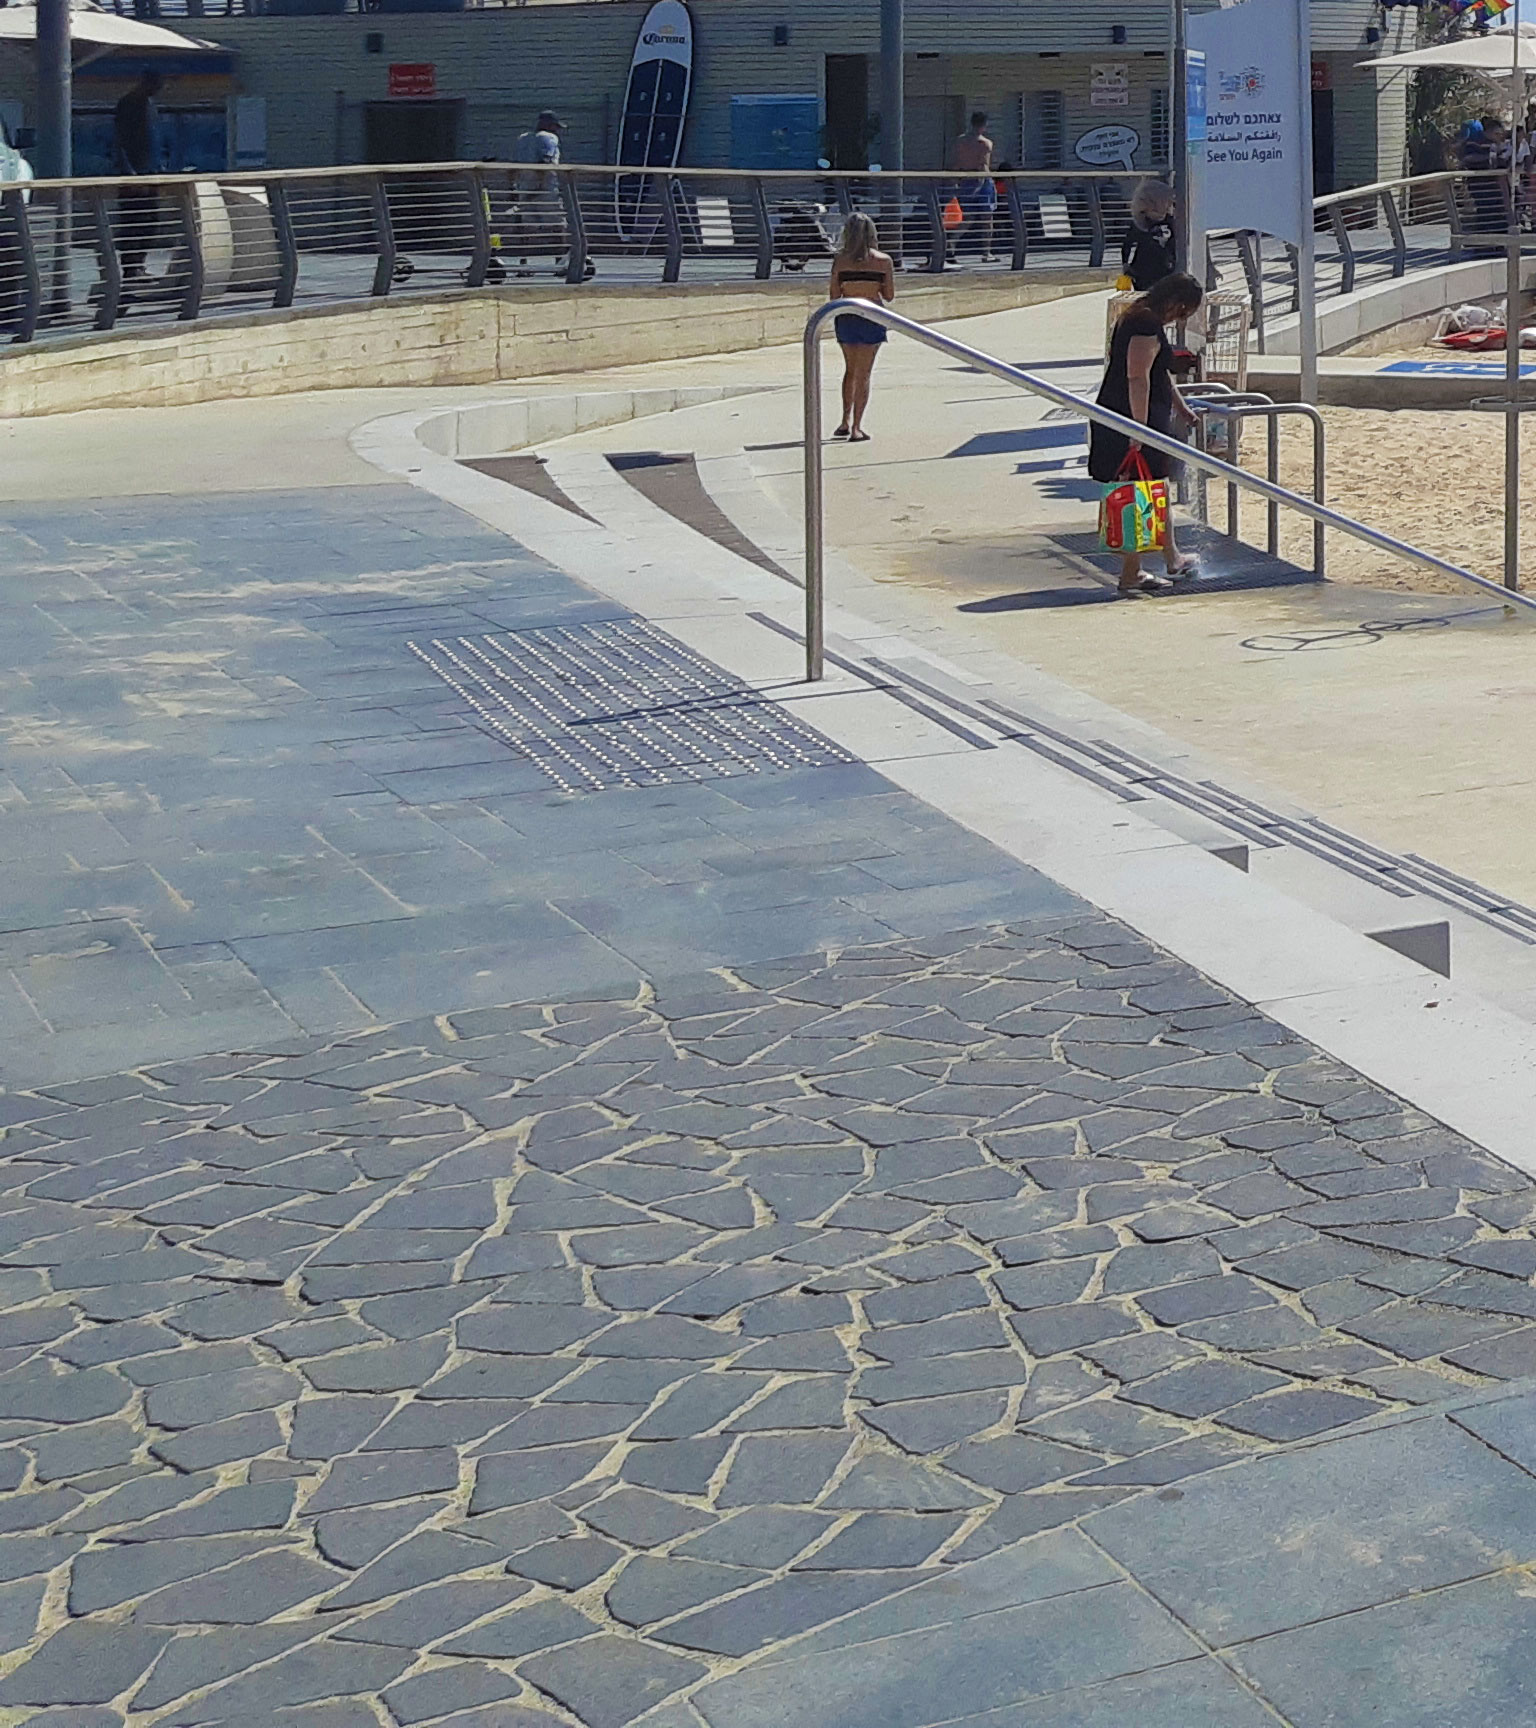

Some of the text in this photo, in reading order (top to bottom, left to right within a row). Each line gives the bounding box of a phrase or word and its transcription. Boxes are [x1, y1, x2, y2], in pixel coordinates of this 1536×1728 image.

[642, 32, 686, 46] Corona
[1206, 111, 1282, 127] צאתכם לשלום
[1206, 146, 1283, 163] See You Again
